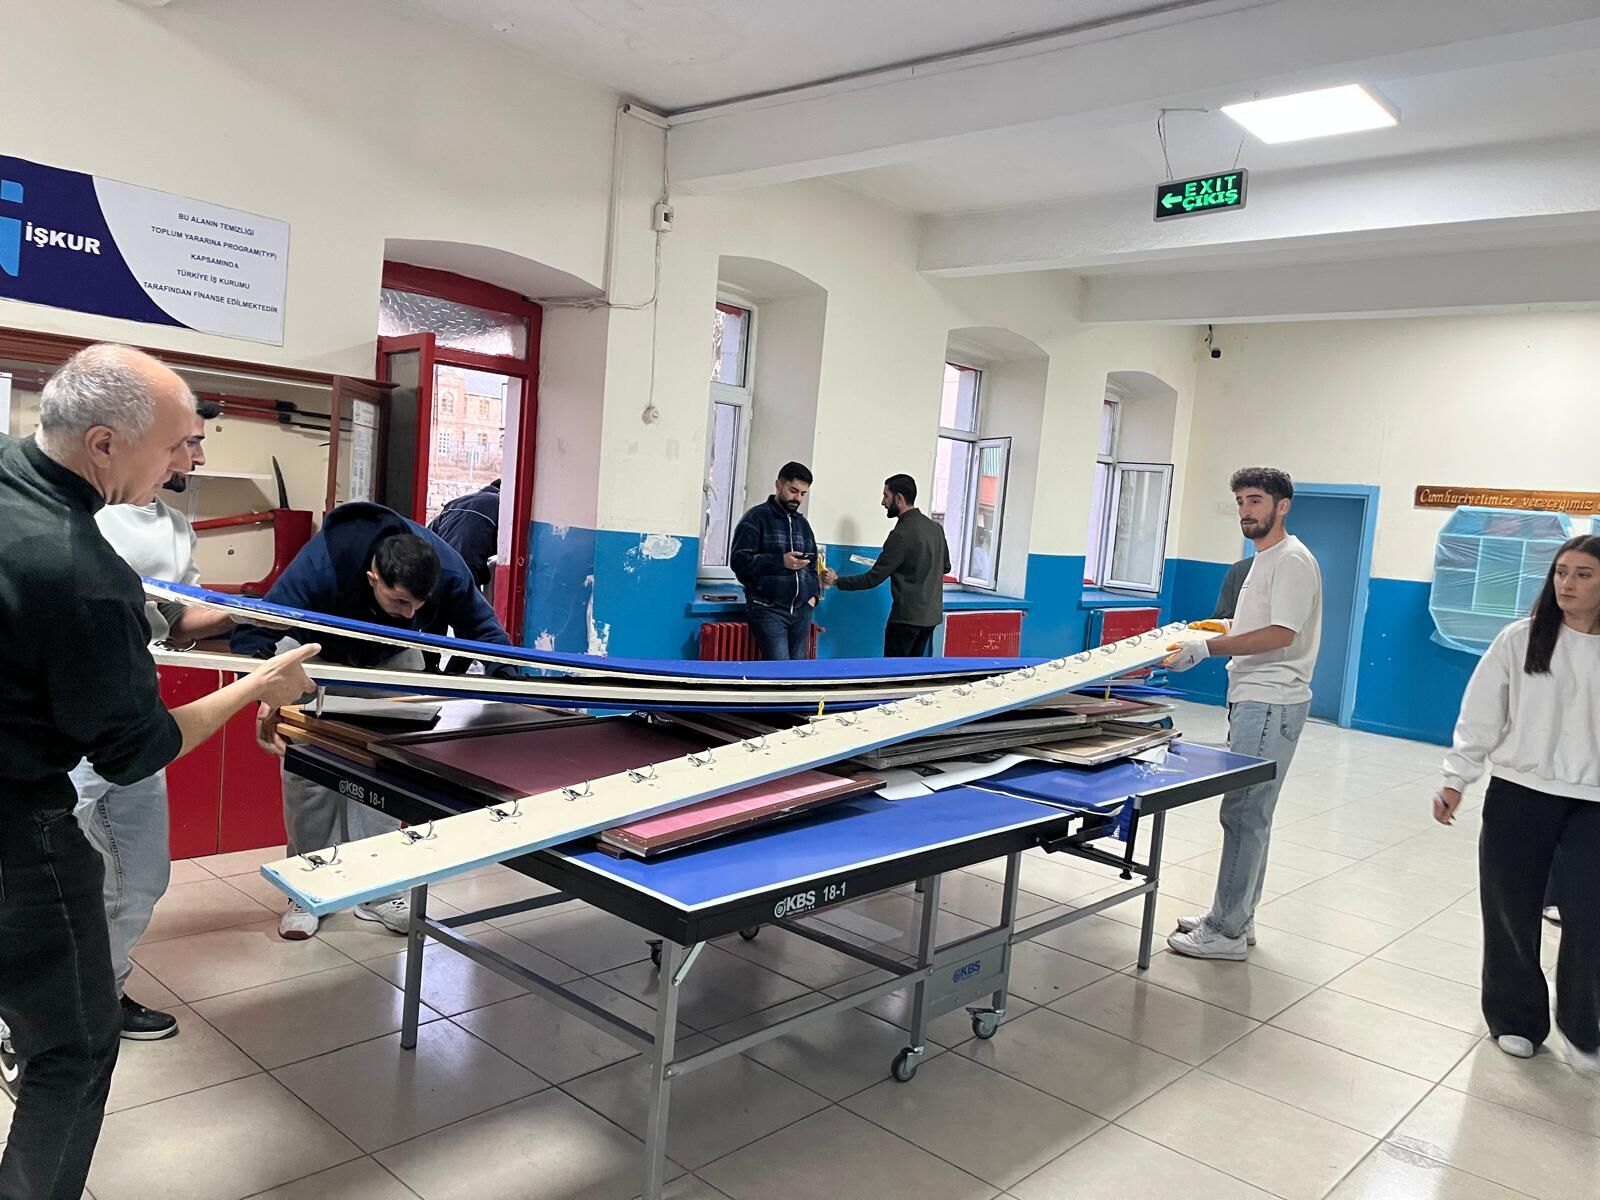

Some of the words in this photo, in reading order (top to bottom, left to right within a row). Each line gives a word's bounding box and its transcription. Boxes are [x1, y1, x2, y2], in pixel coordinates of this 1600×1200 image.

[1185, 175, 1237, 197] EXIT
[1182, 189, 1238, 211] ÇIKIŞ
[178, 212, 189, 221] BU
[190, 216, 218, 228] ALANIN
[25, 221, 101, 255] İŞKUR
[151, 225, 183, 238] TOPLUM
[185, 233, 221, 247] YARARINA
[223, 241, 277, 261] PROGRAM(TYP)
[191, 253, 239, 269] KAPSAMINDA
[176, 268, 208, 281] TÜRKİYE
[210, 274, 218, 284] İŞ
[219, 277, 250, 290] KURUMU
[143, 281, 192, 296] TARAFINDAN
[193, 290, 225, 304] FİNANSE
[226, 297, 278, 313] EDİLMEKTEDİR
[1419, 488, 1517, 506] Cumhuriyetimize
[346, 780, 365, 799] KBS
[369, 791, 385, 808] 18-1
[786, 890, 816, 911] KBS
[823, 881, 846, 902] 18-1
[961, 960, 981, 976] KBS
